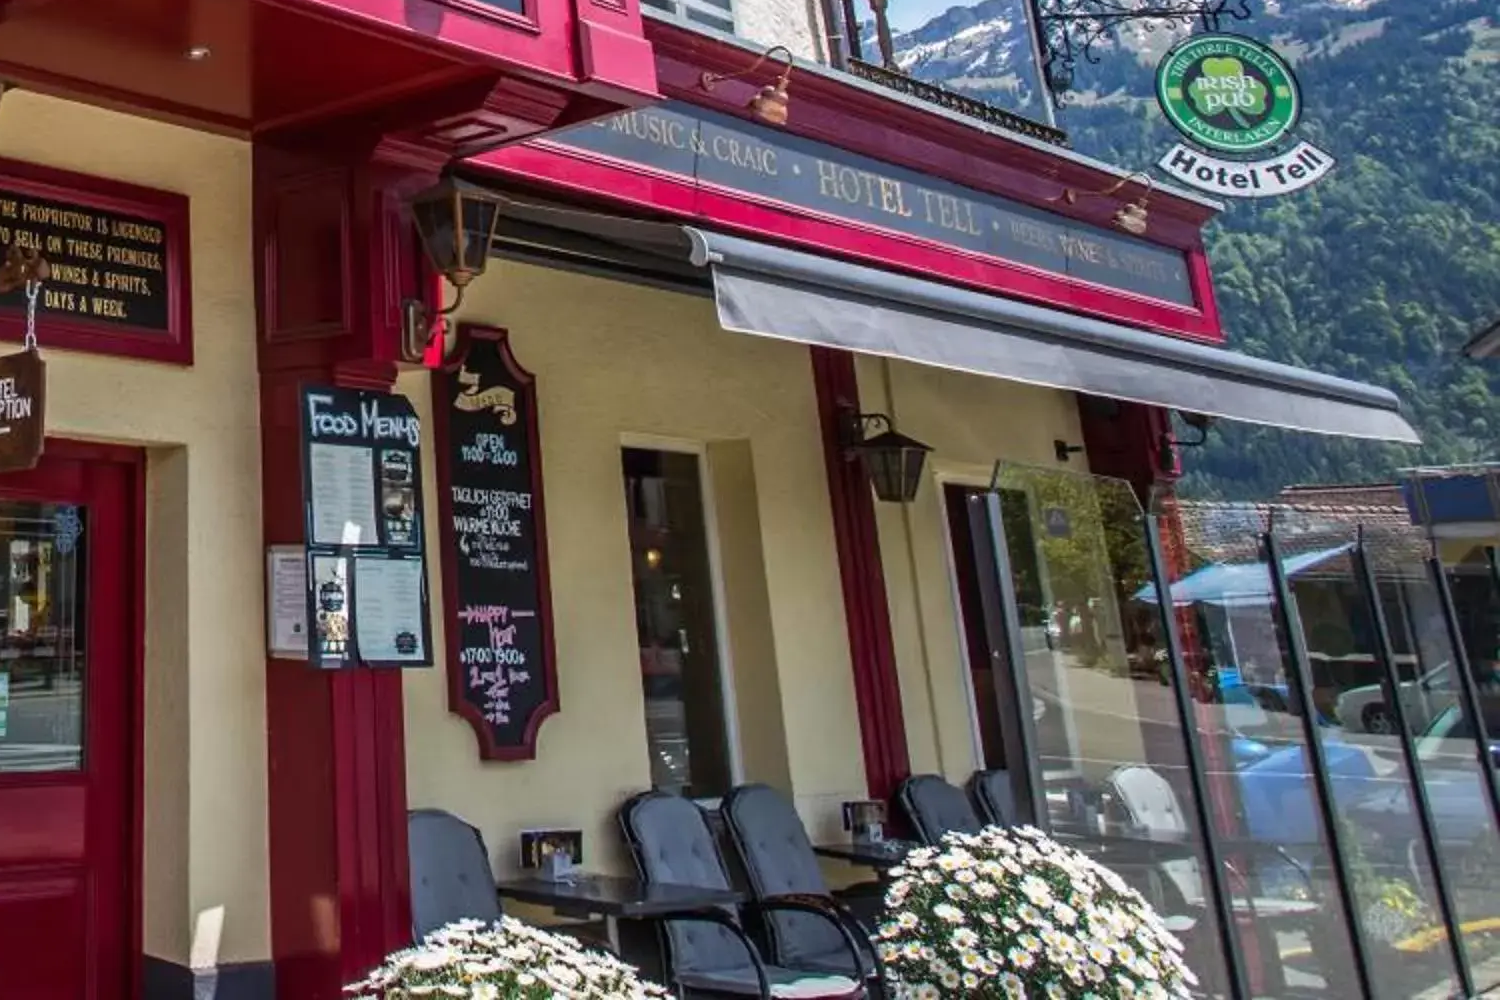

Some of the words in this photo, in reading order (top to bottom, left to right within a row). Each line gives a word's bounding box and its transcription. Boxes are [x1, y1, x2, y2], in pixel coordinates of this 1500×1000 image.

[1170, 54, 1191, 77] THE
[1191, 42, 1234, 62] THREE
[1239, 45, 1277, 78] TELLS
[1188, 116, 1283, 143] INTERLAKEN
[611, 111, 685, 150] MUSIC
[689, 130, 708, 157] &
[712, 135, 779, 176] CRAIC
[816, 159, 913, 218] HOTEL
[917, 188, 983, 237] TELL
[1169, 150, 1261, 189] Hotel
[1265, 149, 1323, 185] Tell
[22, 203, 93, 231] PROPRIETOR
[96, 217, 109, 235] IS
[111, 220, 163, 244] LICENSED
[14, 228, 42, 250] SELL
[46, 235, 63, 253] ON
[67, 239, 104, 261] THESE
[51, 263, 88, 285] WINES
[91, 270, 100, 287] &
[104, 272, 152, 296] SPIRITS,
[44, 288, 76, 311] DAYS
[79, 296, 88, 313] A
[475, 433, 504, 449] OPEN
